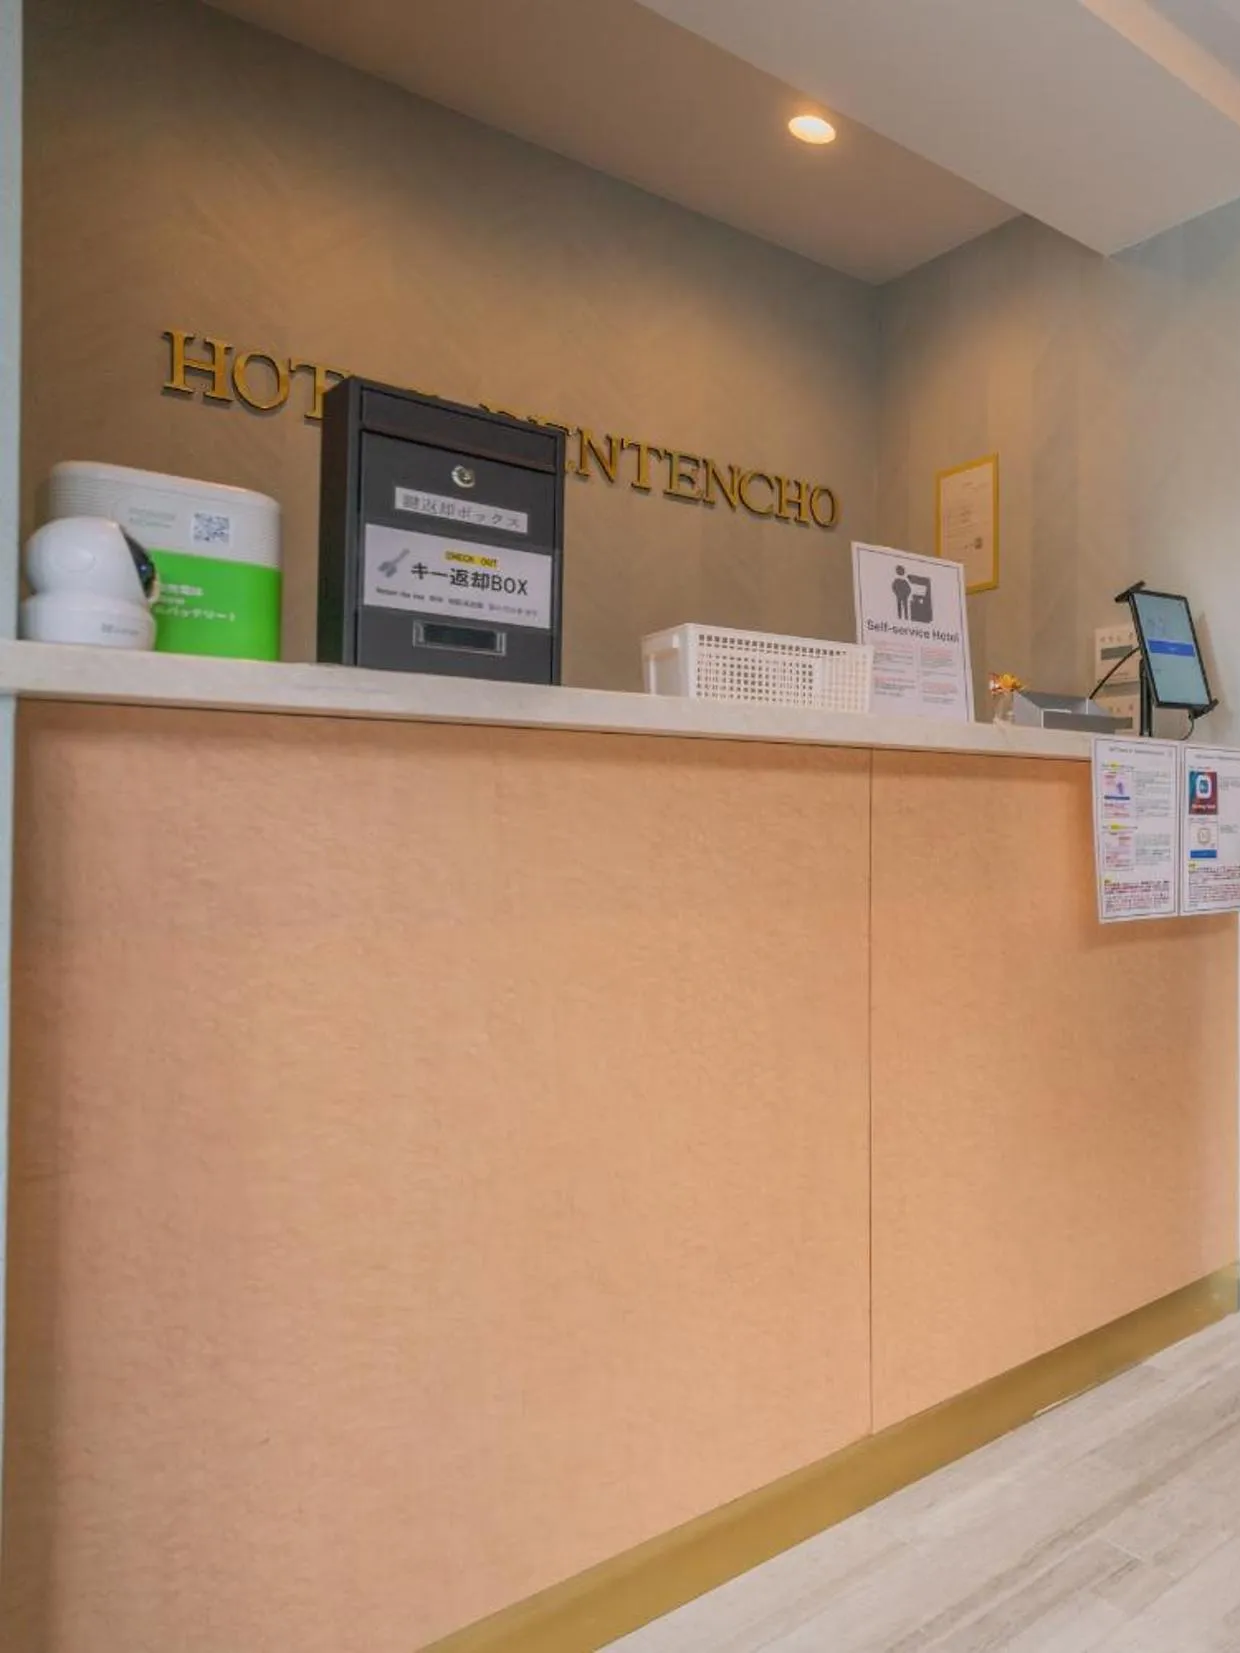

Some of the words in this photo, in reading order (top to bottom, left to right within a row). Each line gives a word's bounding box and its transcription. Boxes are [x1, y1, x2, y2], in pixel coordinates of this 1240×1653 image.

[478, 402, 838, 528] NTENCHO
[410, 561, 529, 597] キー返却BOX
[867, 618, 931, 640] Self-service
[932, 628, 960, 644] Hotel
